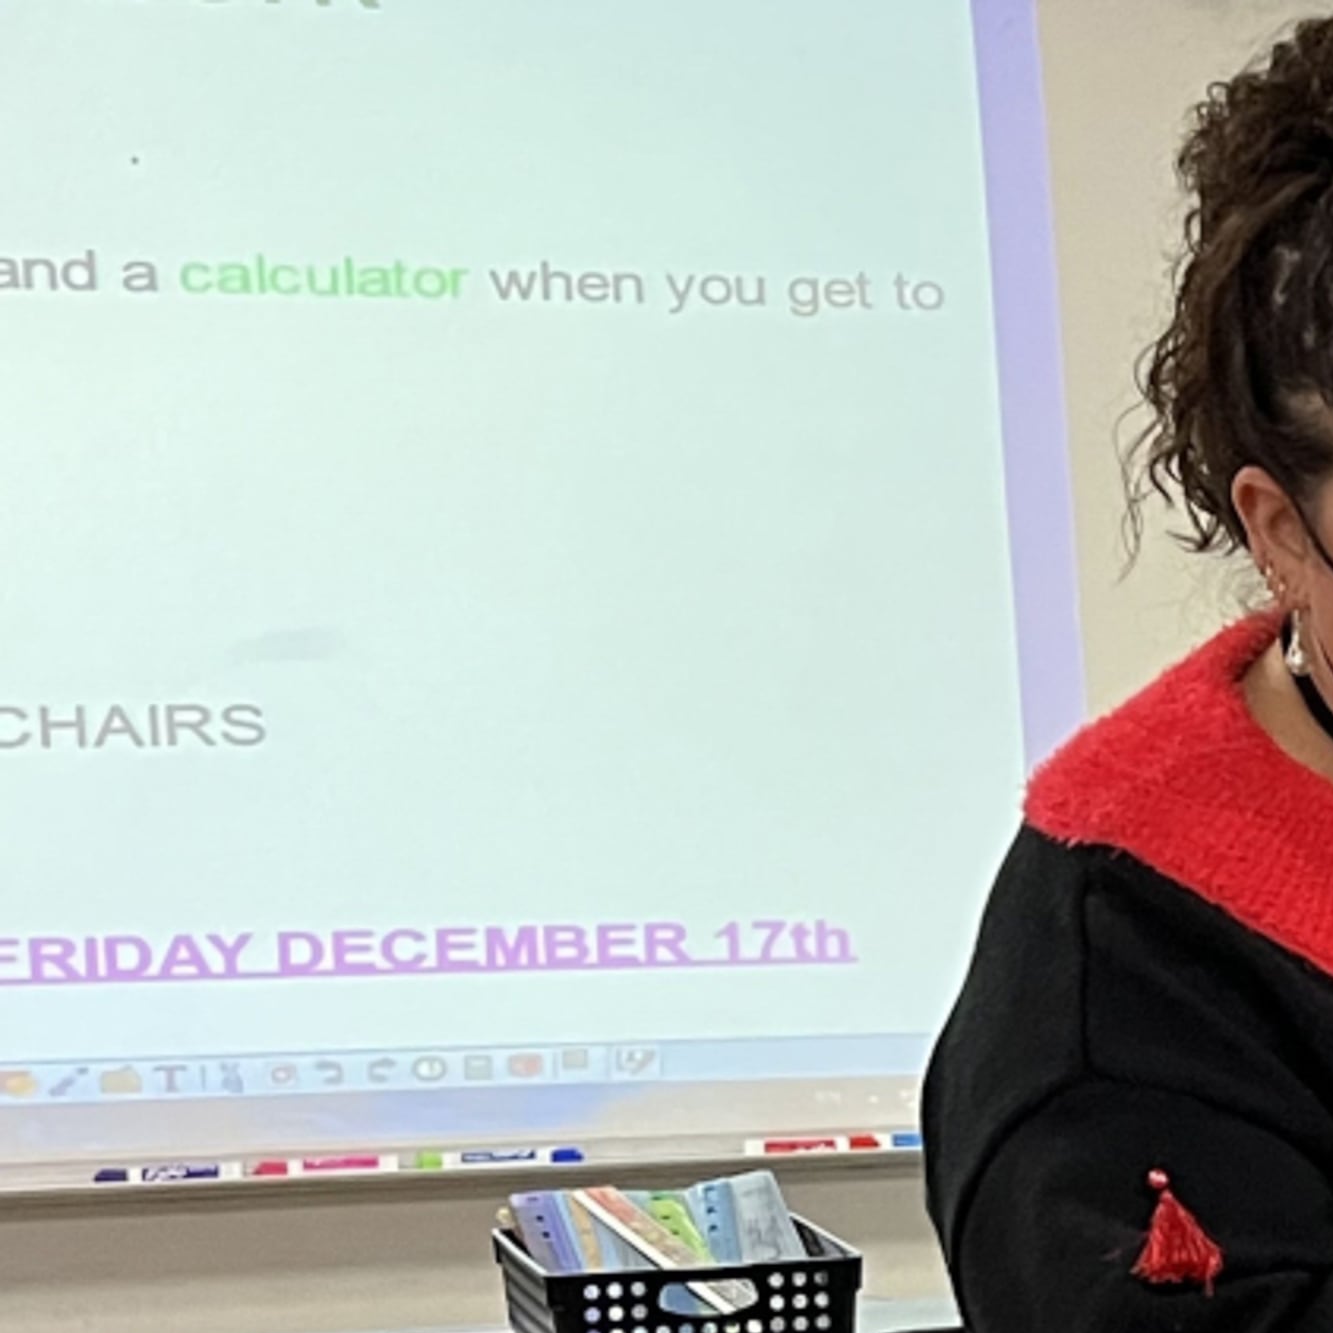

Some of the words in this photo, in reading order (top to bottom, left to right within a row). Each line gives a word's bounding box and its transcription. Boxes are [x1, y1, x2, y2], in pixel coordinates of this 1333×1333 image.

[121, 259, 159, 293] a
[178, 255, 469, 301] calculator
[489, 262, 645, 305] when
[666, 269, 767, 313] you
[787, 271, 873, 317] get
[893, 272, 945, 312] to
[277, 922, 689, 974] DECEMBER
[714, 918, 853, 963] 17th
